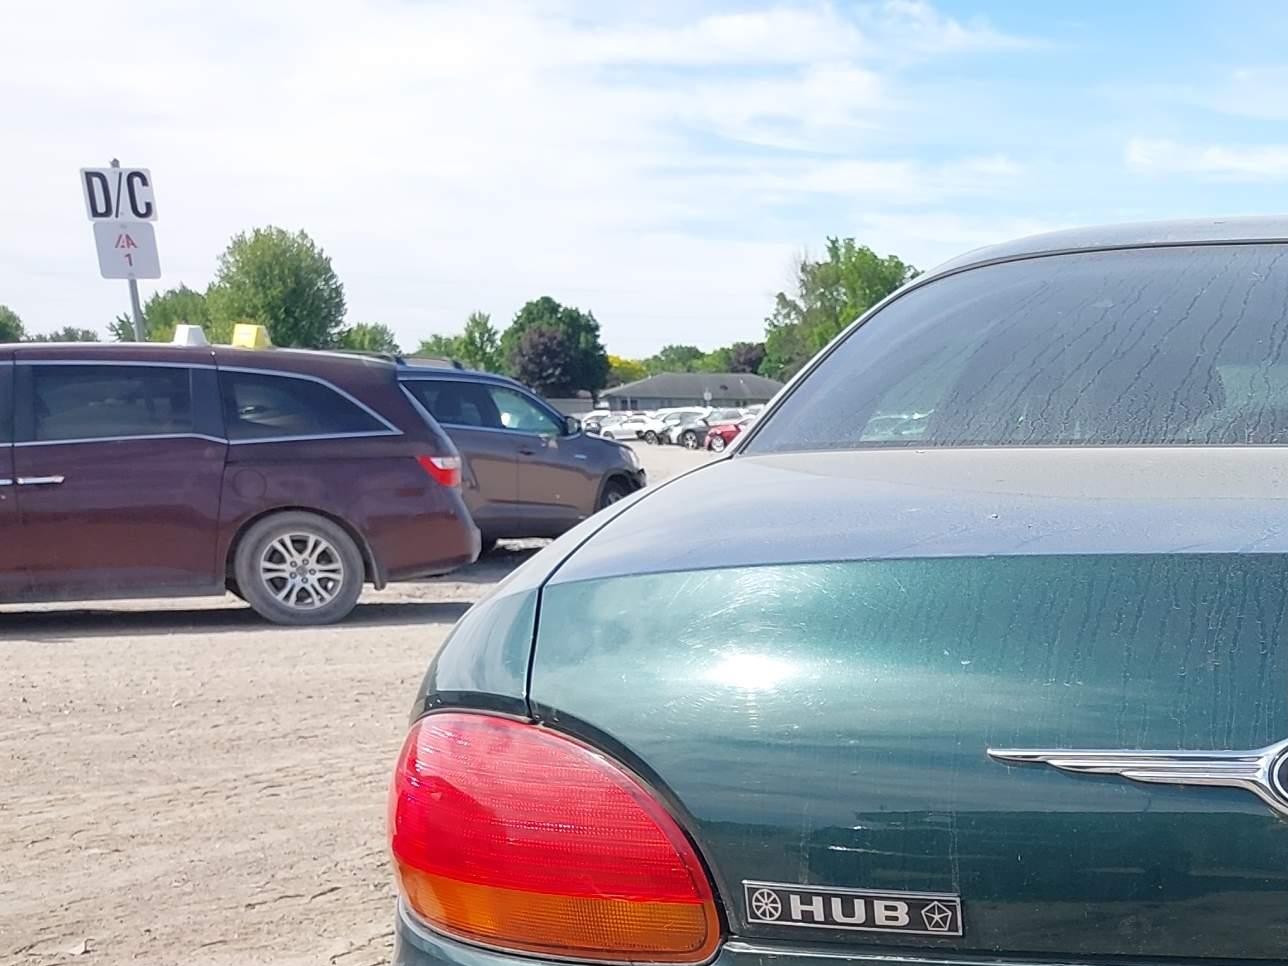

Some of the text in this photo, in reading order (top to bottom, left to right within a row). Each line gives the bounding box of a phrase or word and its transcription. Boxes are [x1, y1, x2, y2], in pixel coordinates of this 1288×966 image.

[84, 171, 153, 218] D/C
[125, 253, 133, 267] 1
[789, 894, 910, 927] HUB
